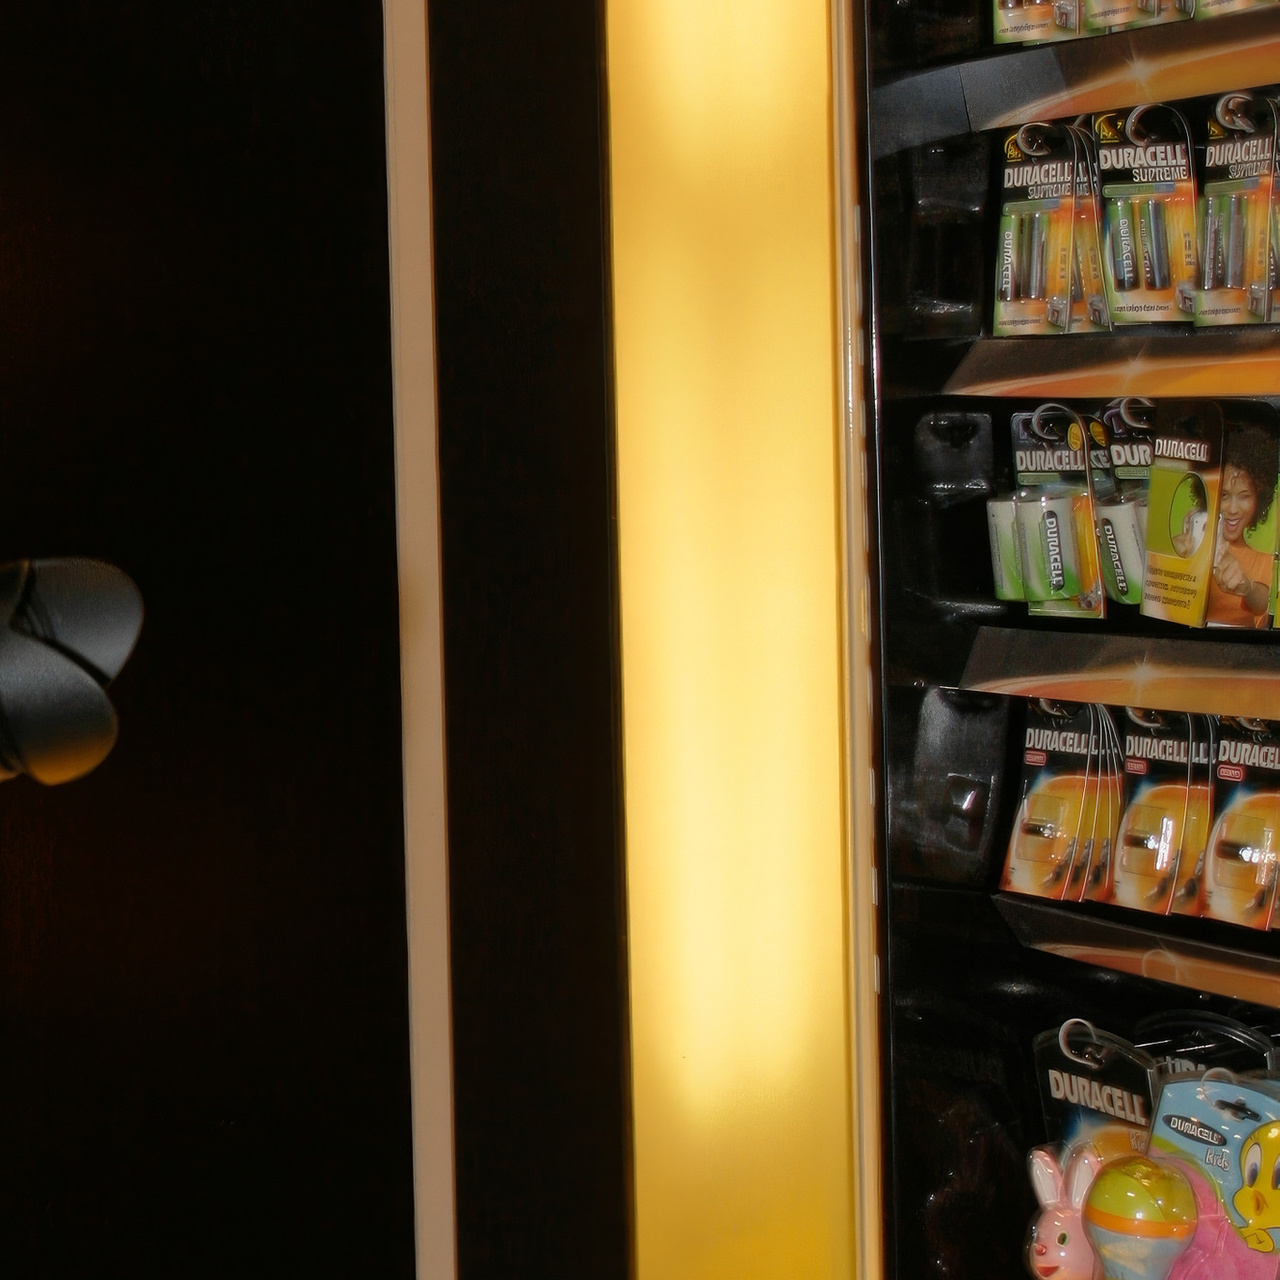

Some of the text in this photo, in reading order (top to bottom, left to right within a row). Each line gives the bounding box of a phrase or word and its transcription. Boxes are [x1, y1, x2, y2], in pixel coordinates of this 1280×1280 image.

[1099, 144, 1186, 170] DURACELL
[1206, 138, 1270, 167] DURACELL
[1004, 162, 1071, 188] DURACELL
[1132, 165, 1188, 182] SUPREME
[1016, 450, 1084, 471] DURACELL
[1154, 438, 1209, 461] DURACELL
[1047, 517, 1063, 589] DURACELL
[1025, 728, 1088, 754] DURACELL
[1126, 735, 1188, 761] DURACELL
[1049, 1068, 1147, 1125] DURACELL
[1169, 1117, 1222, 1145] DURACELL
